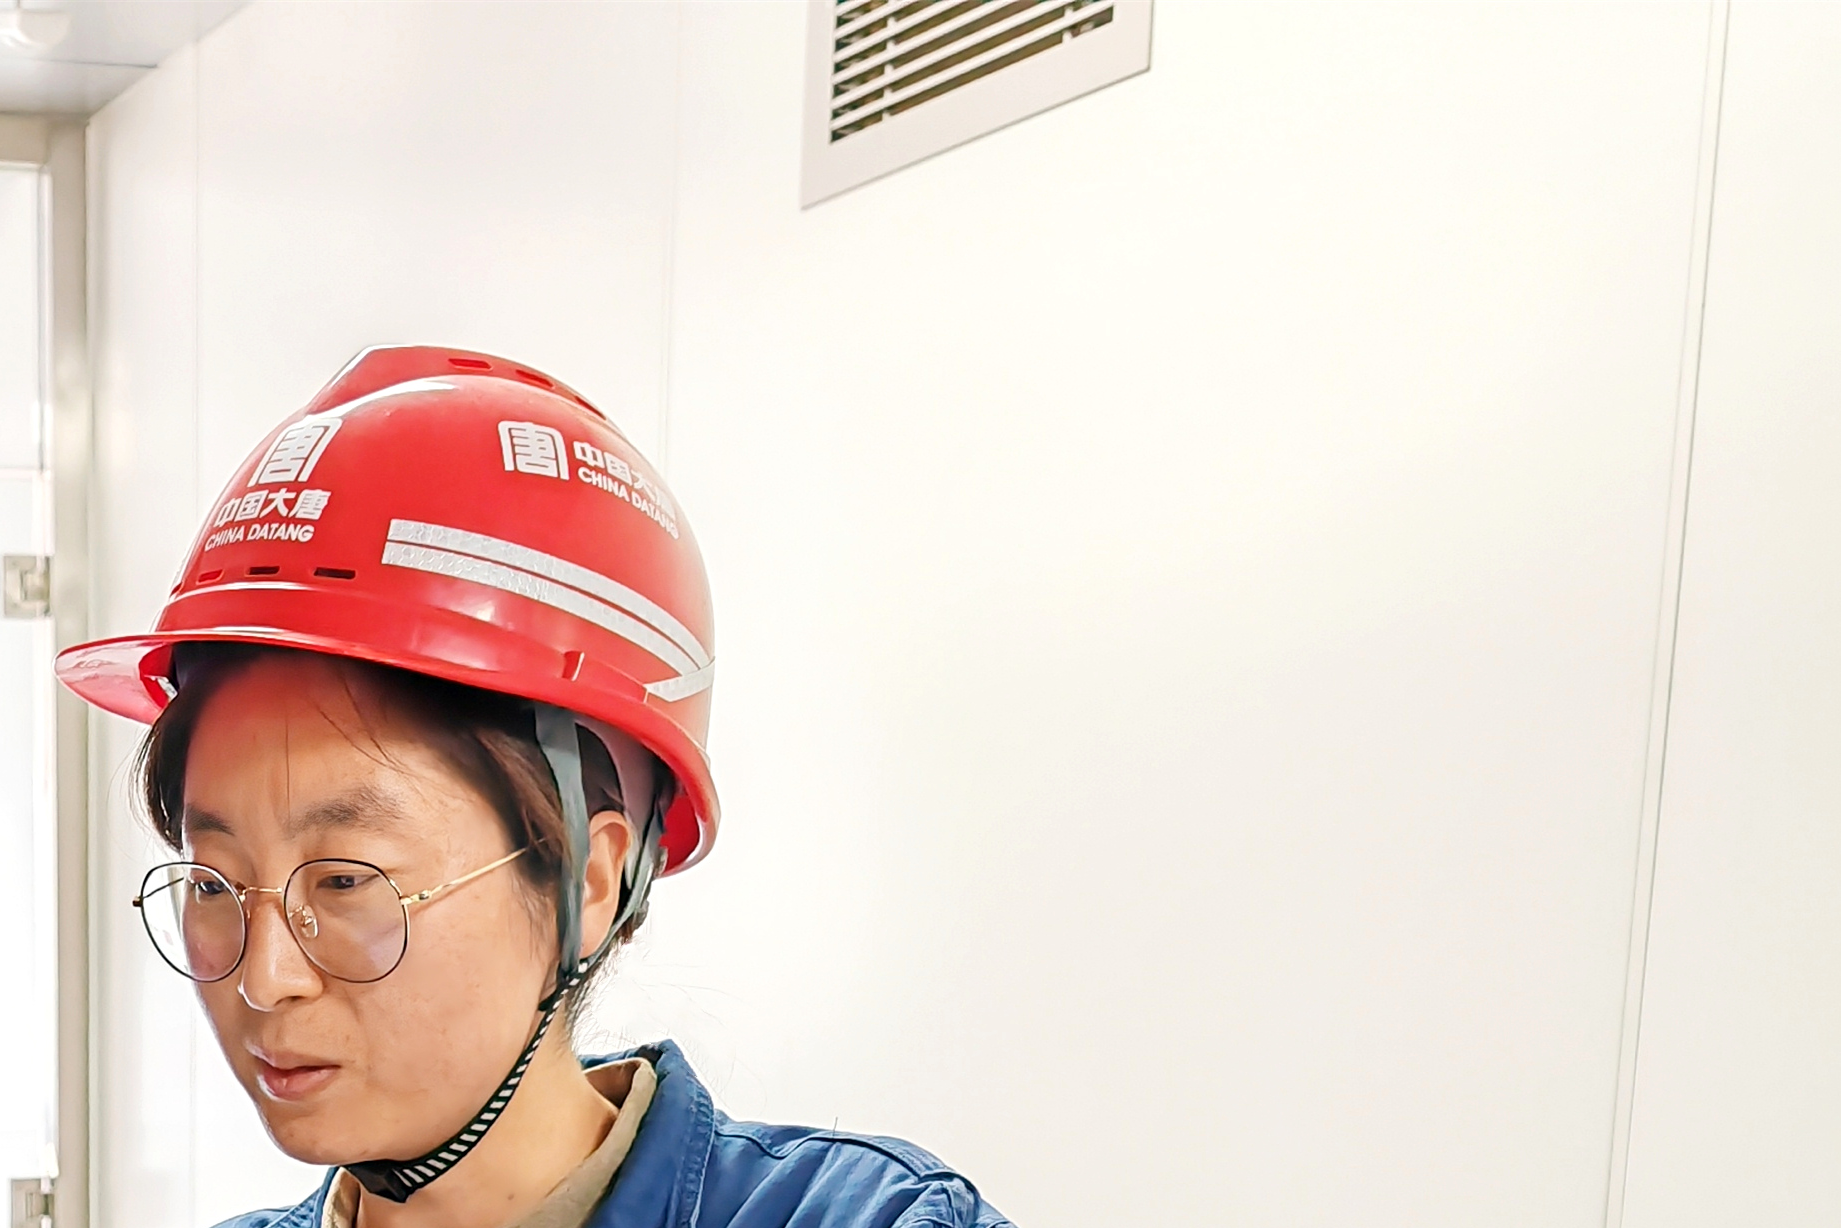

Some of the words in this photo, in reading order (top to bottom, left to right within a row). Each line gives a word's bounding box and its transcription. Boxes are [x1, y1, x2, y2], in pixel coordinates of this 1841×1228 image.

[212, 487, 332, 528] 中国大唐
[577, 466, 631, 502] CHINA
[630, 490, 680, 540] DATANG
[204, 525, 245, 552] CHINA
[246, 522, 315, 543] DATANG
